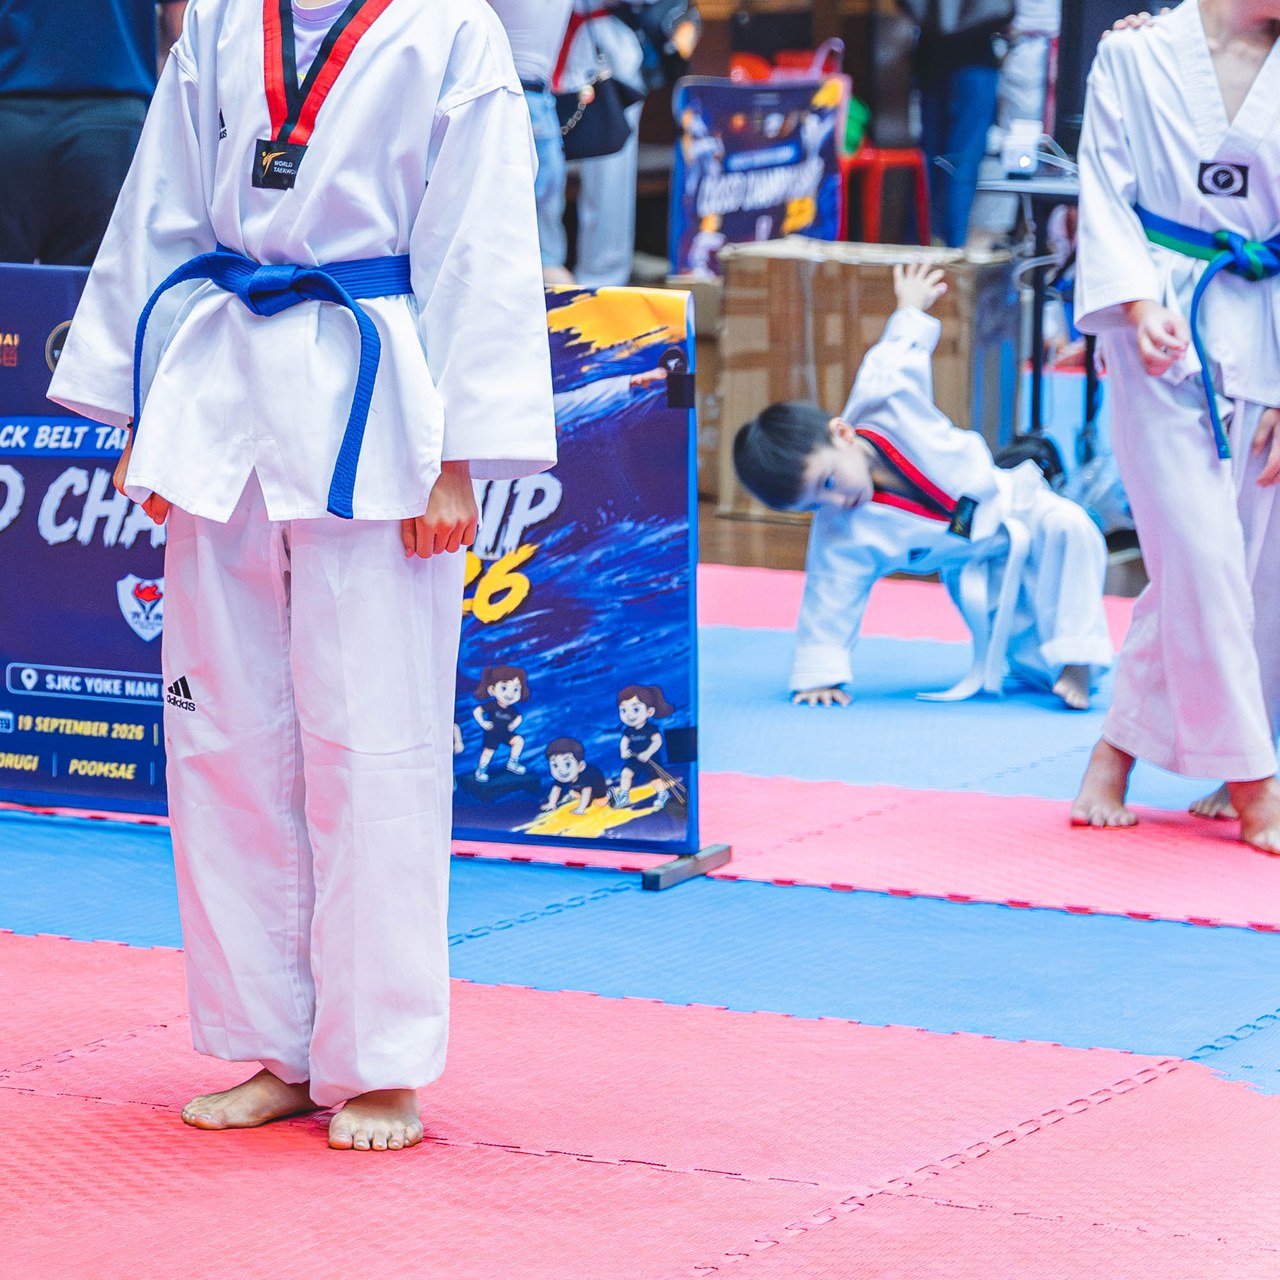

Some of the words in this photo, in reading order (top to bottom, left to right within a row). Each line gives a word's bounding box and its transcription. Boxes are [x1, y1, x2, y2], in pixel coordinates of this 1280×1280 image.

[273, 167, 297, 175] TAEKWO
[33, 425, 88, 449] BELT
[45, 673, 82, 692] SJKC
[84, 676, 123, 696] YOKE
[125, 679, 158, 698] NAM
[17, 714, 32, 731] 19
[35, 716, 109, 738] SEPTEMBER
[111, 723, 145, 741] 2026
[68, 758, 137, 780] POOMSAE
